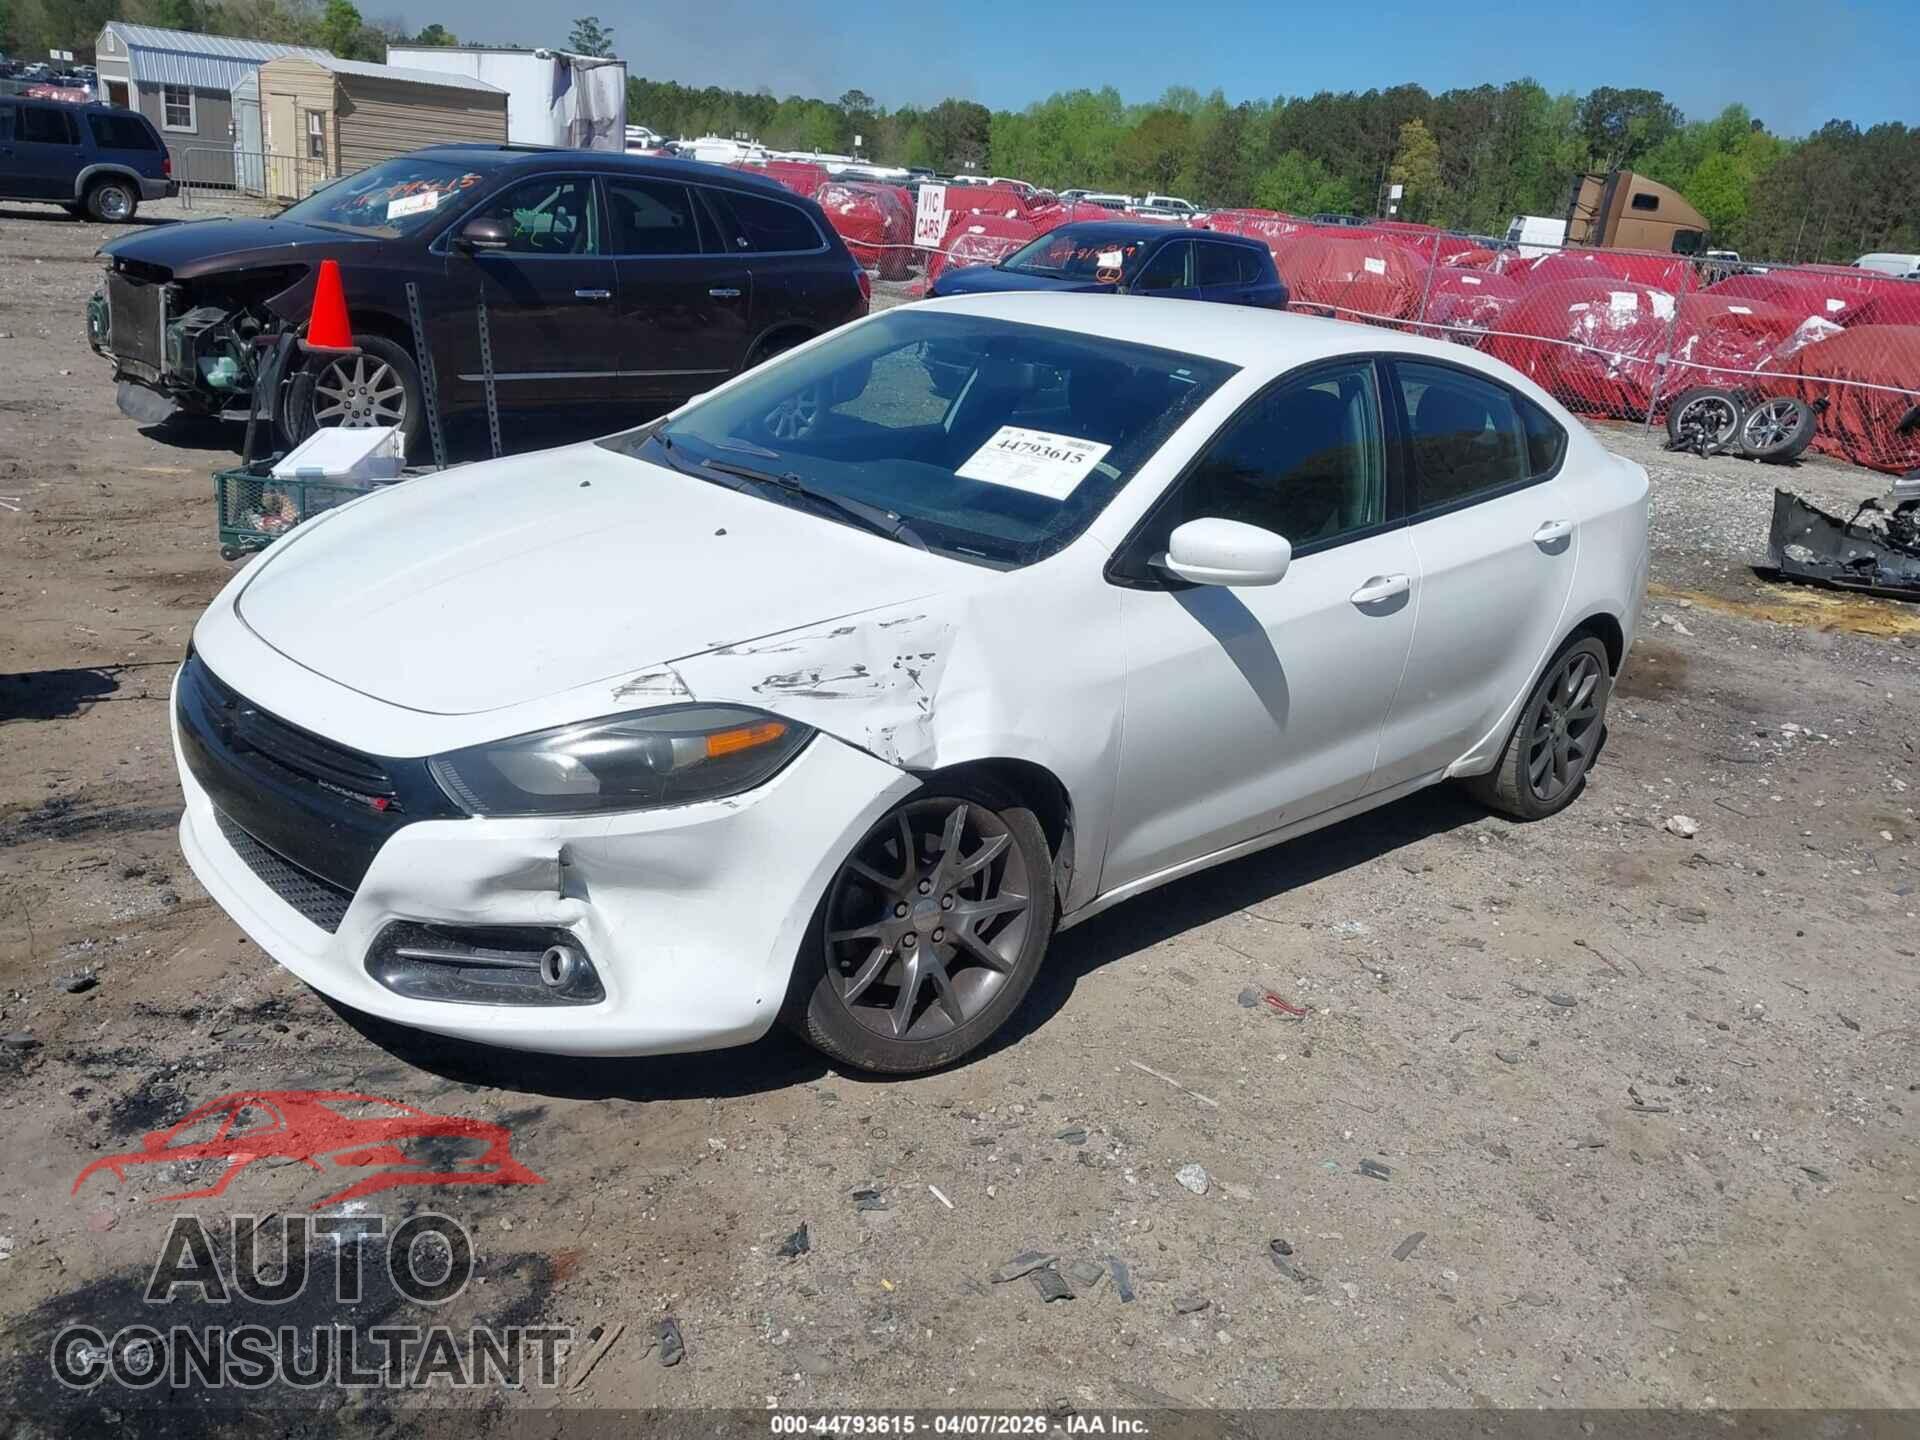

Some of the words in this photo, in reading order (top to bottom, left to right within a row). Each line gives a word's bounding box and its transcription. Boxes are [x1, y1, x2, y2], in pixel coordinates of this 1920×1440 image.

[923, 192, 939, 212] VIC
[917, 218, 940, 240] CARS
[996, 438, 1087, 464] 44793615
